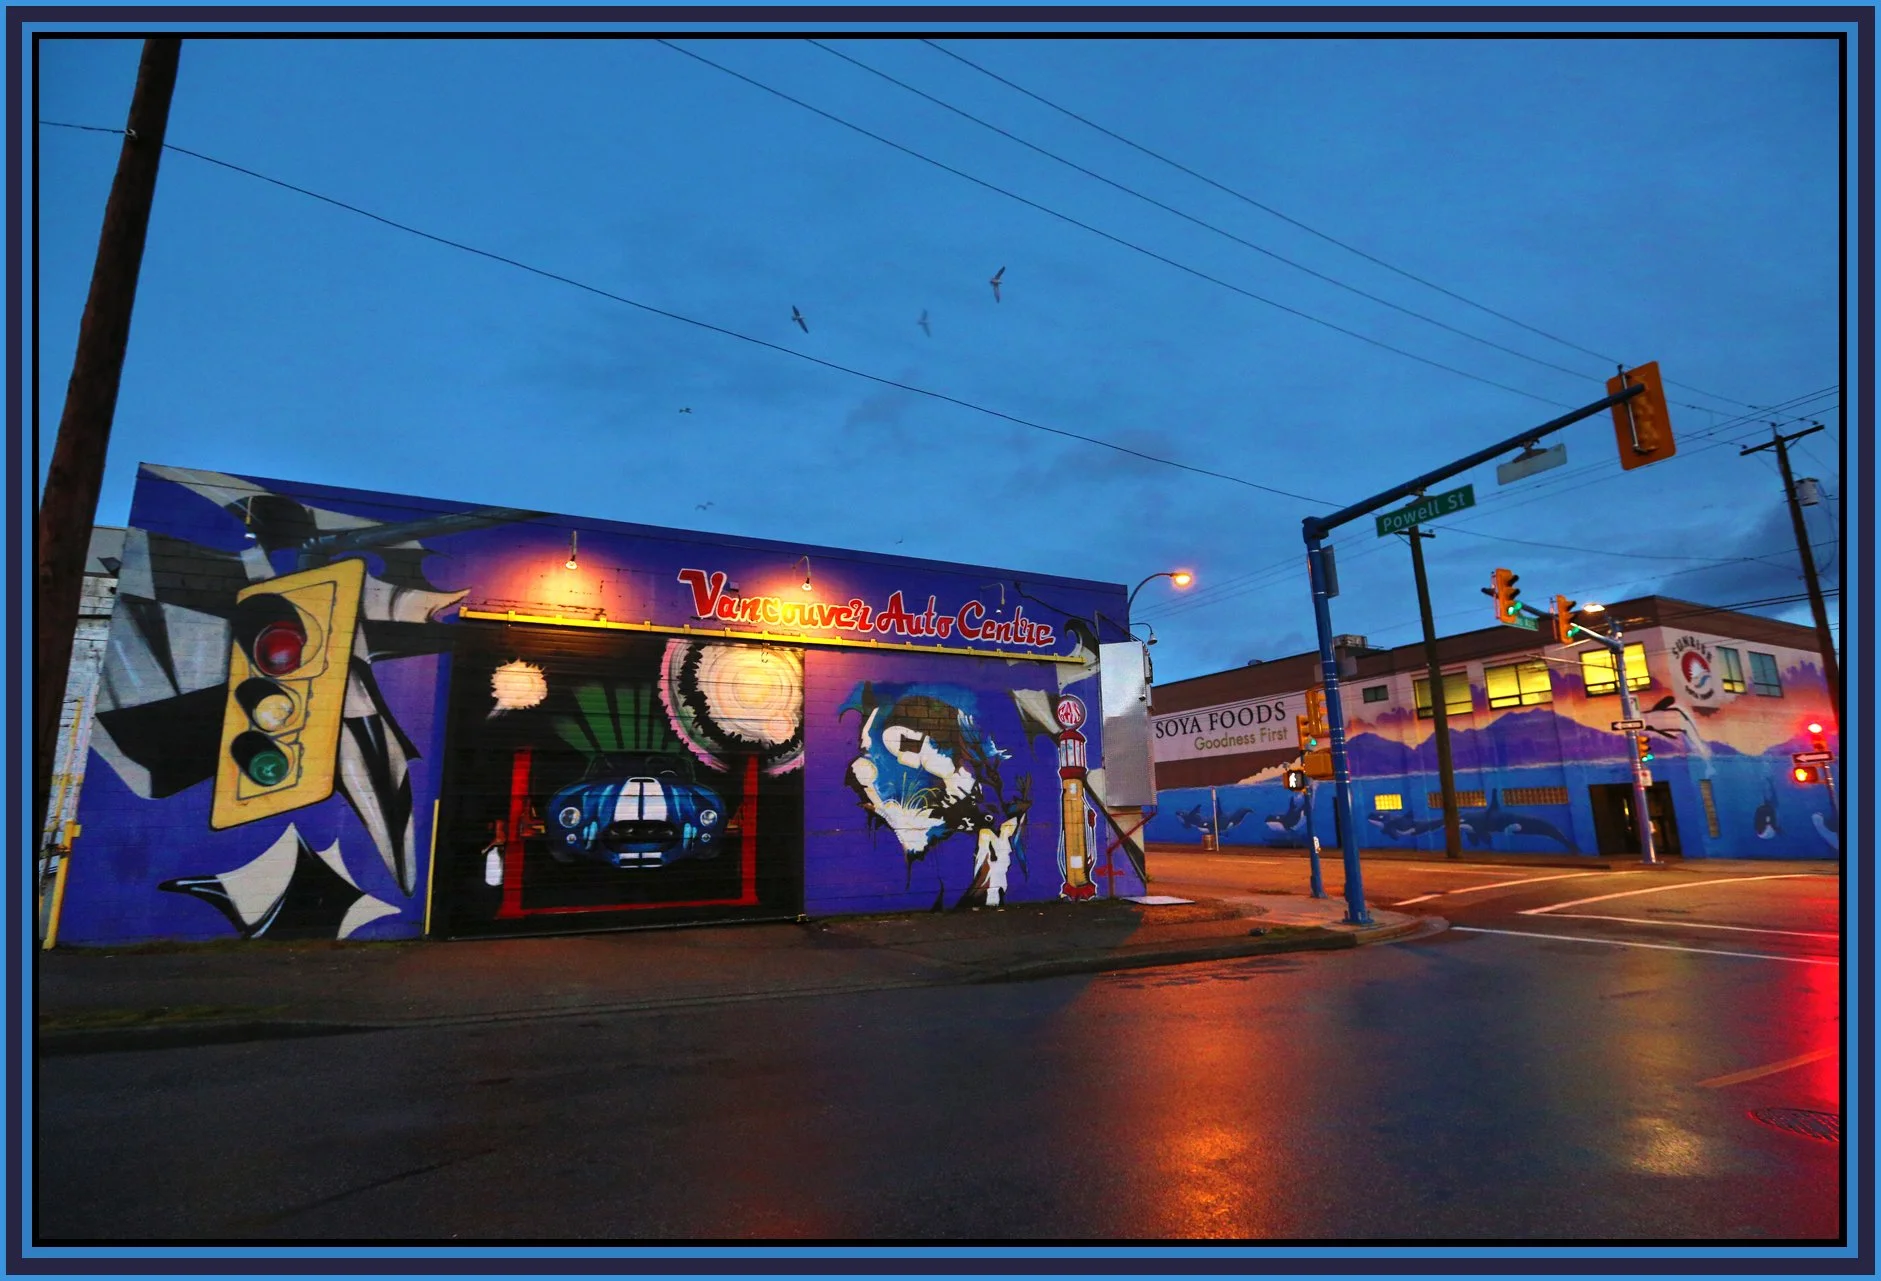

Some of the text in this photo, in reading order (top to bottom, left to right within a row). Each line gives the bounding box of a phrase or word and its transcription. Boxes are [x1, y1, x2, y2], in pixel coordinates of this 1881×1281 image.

[1382, 492, 1466, 532] Powell St
[677, 568, 1056, 647] Vancouver Auto Centre
[1155, 701, 1287, 739] SOYA FOODS
[1194, 726, 1288, 751] Goodness First
